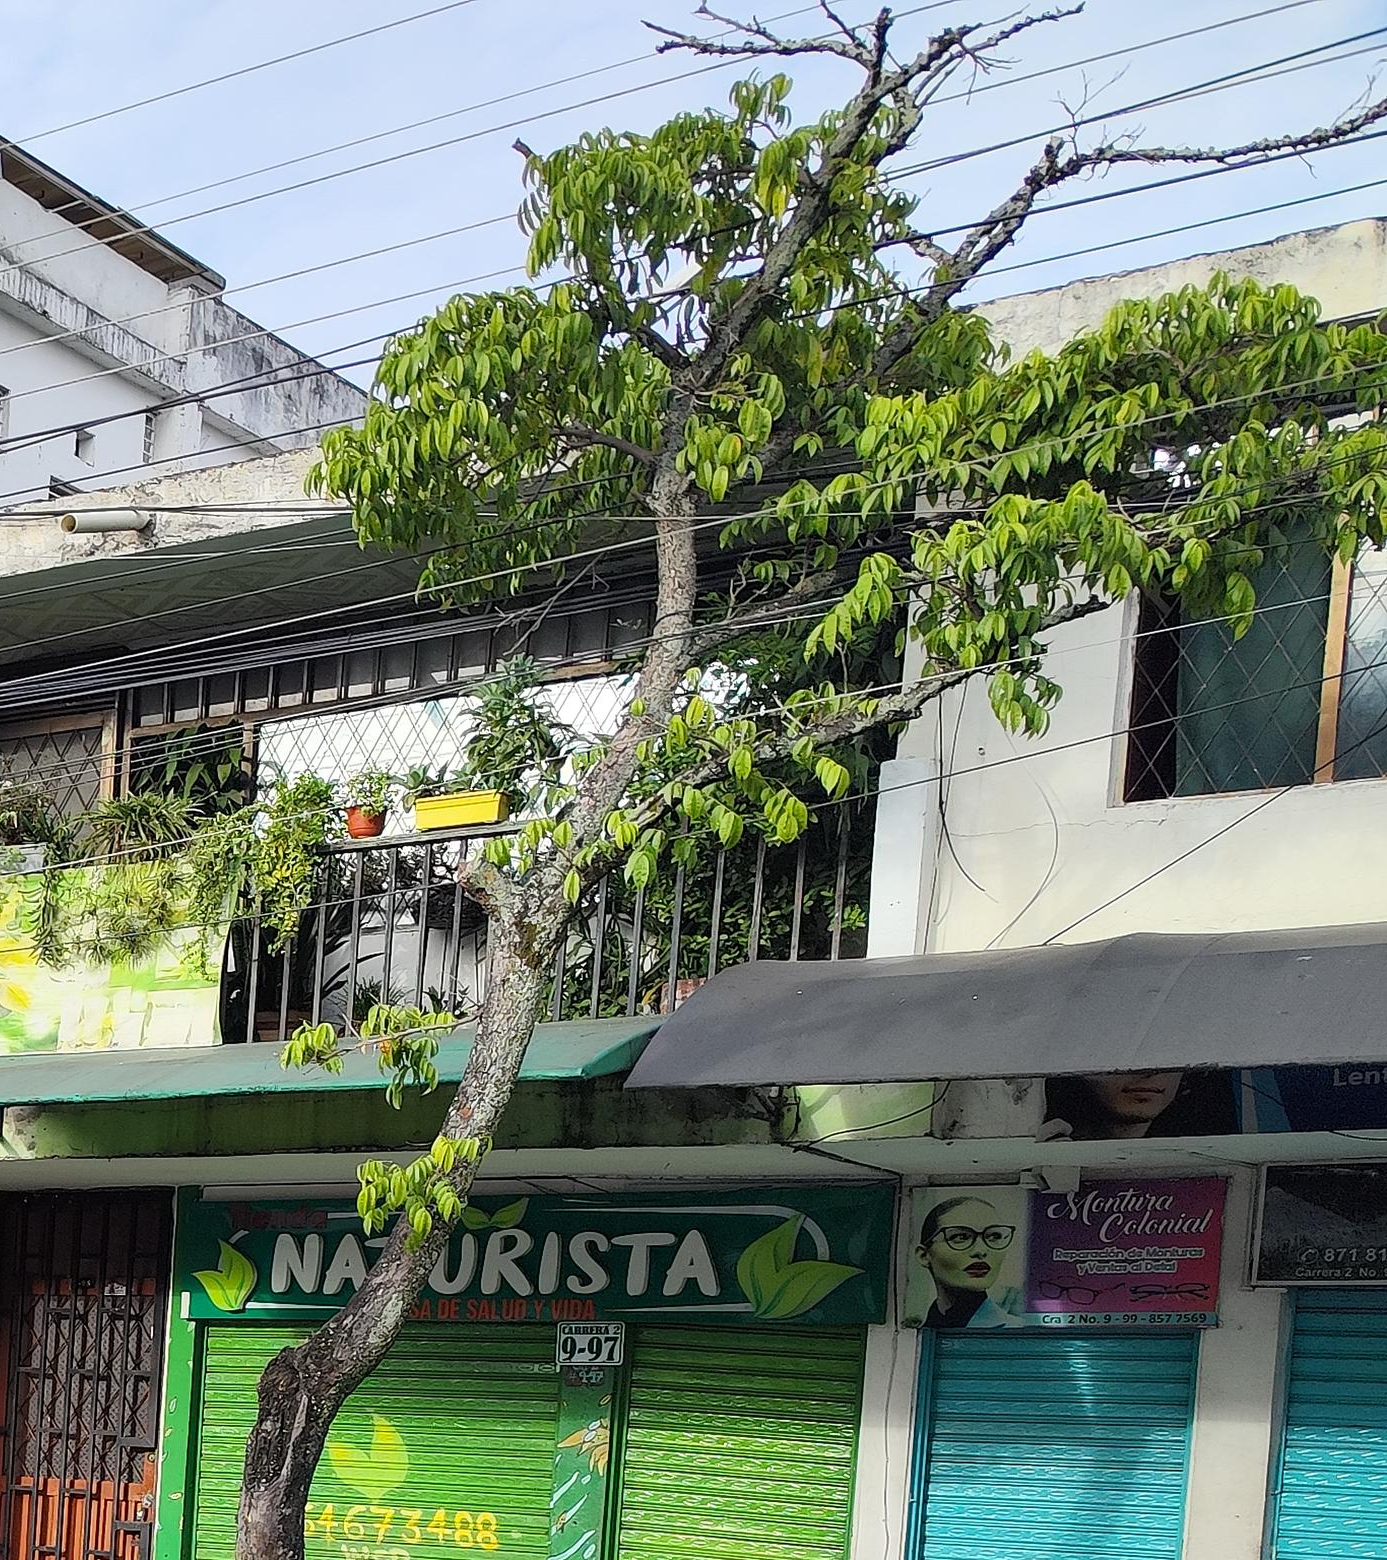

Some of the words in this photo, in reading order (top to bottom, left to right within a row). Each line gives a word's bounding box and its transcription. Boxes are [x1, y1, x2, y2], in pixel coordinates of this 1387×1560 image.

[1047, 1187, 1174, 1226] Montura
[1098, 1208, 1214, 1243] Colonial
[1127, 1248, 1143, 1259] de
[1145, 1247, 1205, 1259] Monturas
[1323, 1247, 1358, 1263] 871
[1144, 1260, 1176, 1273] Detal
[1344, 1267, 1353, 1278] 2
[437, 1299, 464, 1320] DE
[467, 1299, 526, 1320] SALUD
[533, 1299, 544, 1320] Y
[551, 1299, 596, 1321] VIDA
[1068, 1314, 1076, 1324] 2
[1079, 1314, 1100, 1324] No.
[1103, 1314, 1112, 1324] 9
[1122, 1314, 1138, 1323] 99
[1148, 1313, 1172, 1323] 857
[1175, 1312, 1207, 1323] 7569
[562, 1325, 610, 1335] CARRERA
[613, 1325, 620, 1335] 2
[562, 1336, 620, 1361] 9-97
